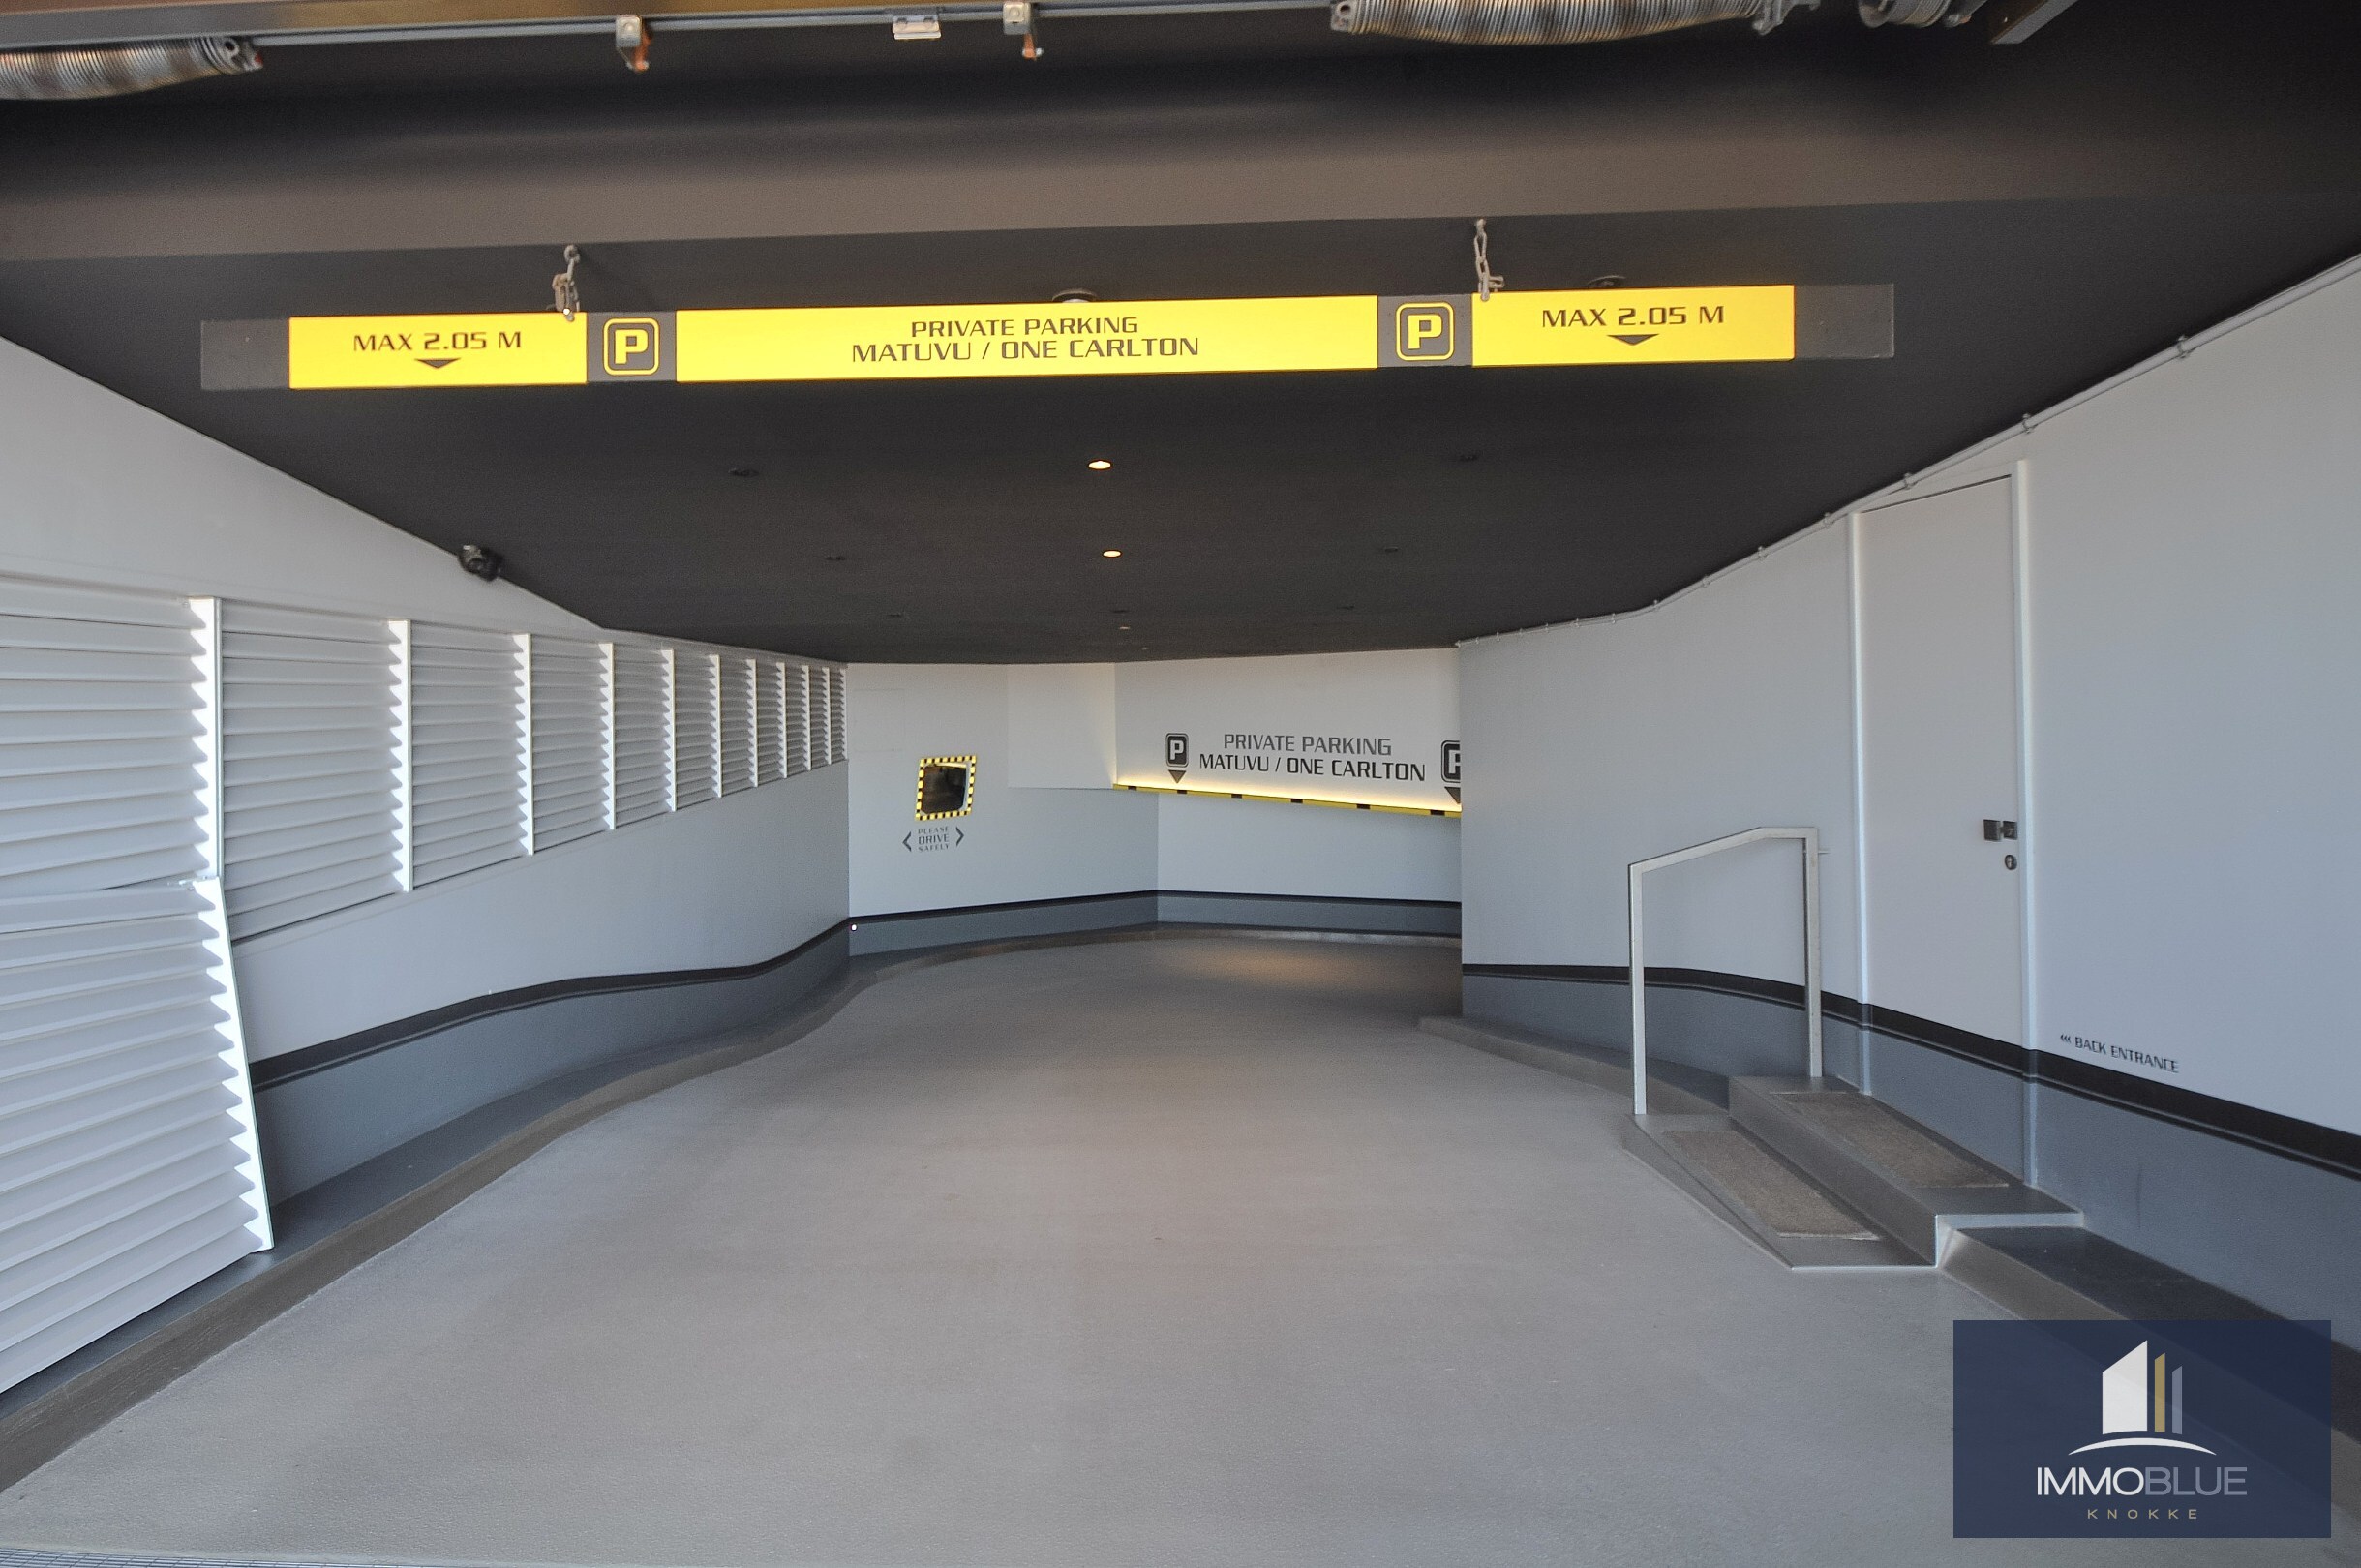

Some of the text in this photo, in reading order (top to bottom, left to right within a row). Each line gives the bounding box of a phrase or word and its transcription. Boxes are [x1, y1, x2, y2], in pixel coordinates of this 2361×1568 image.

[911, 317, 1138, 337] PRIVATE PARKING
[1542, 306, 1725, 327] MAX 2.05 M
[352, 331, 522, 351] MAX 2.05 M
[852, 342, 972, 363] MATUVU
[1001, 340, 1058, 360] ONE
[1069, 337, 1199, 358] CARLTON
[1224, 734, 1392, 756] PRIVATE PARKING
[1199, 753, 1269, 772] MATUVU
[1286, 757, 1324, 775] ONE
[1331, 759, 1425, 781] CARLTON
[918, 826, 949, 834] PLEASE
[918, 833, 949, 845] DRIVE
[2074, 1036, 2179, 1073] BACK ENTRANCE
